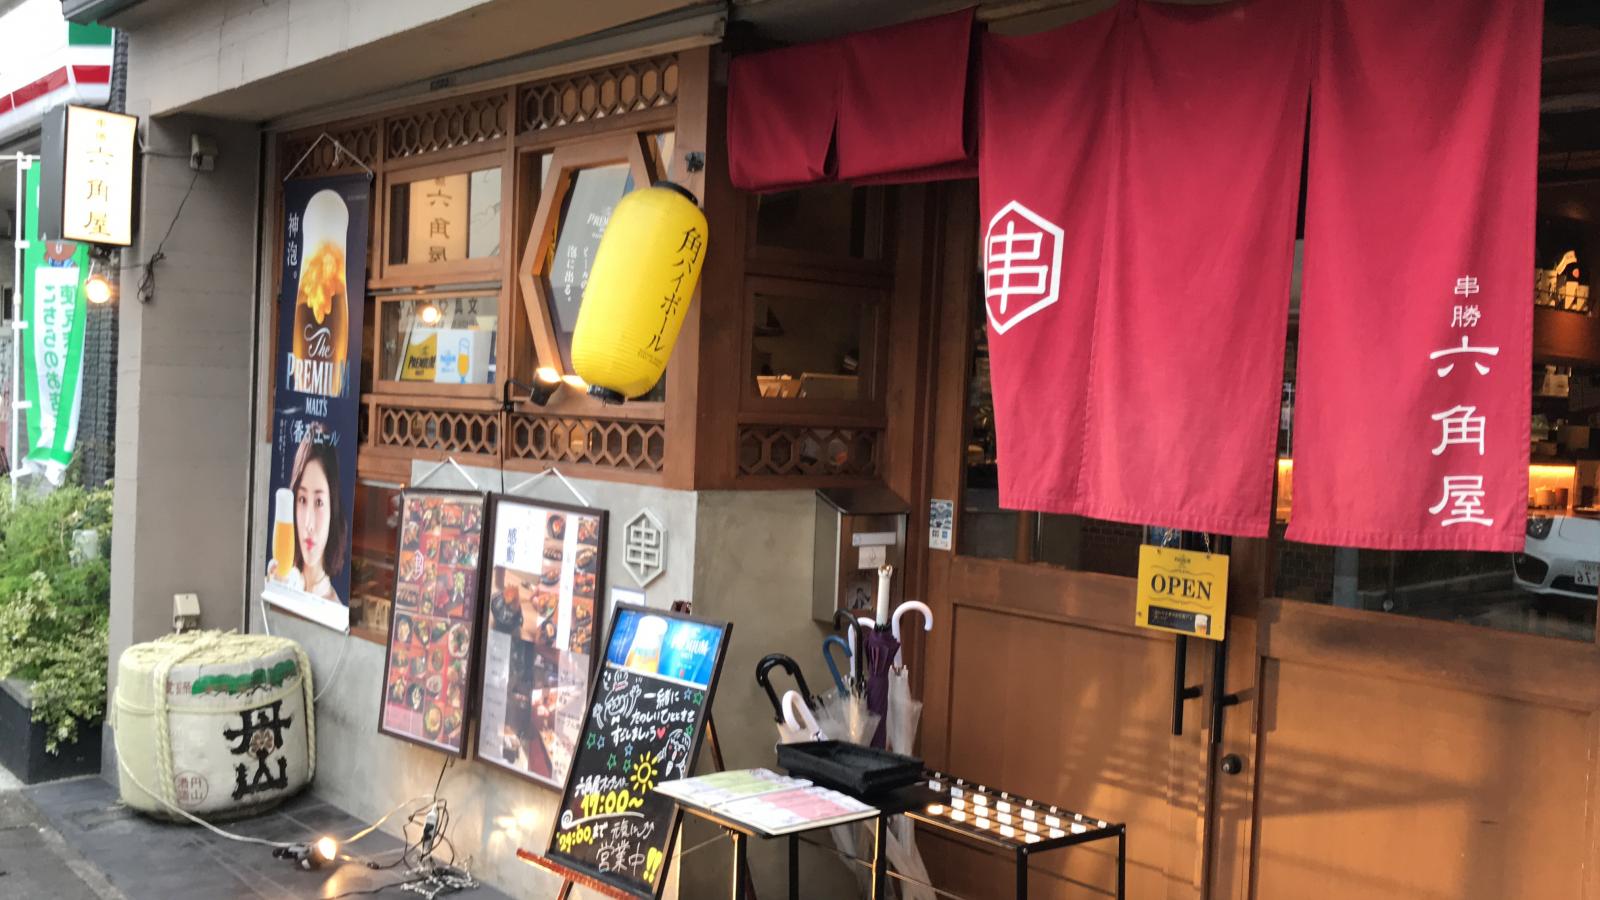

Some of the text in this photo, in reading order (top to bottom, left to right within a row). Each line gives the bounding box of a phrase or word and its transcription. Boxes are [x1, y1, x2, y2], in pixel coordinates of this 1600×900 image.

[647, 227, 703, 352] 角ハイボール
[987, 220, 1048, 314] 串
[1451, 275, 1481, 328] 串勝
[286, 352, 350, 398] PREMIUM
[1429, 335, 1500, 527] 六角屋
[626, 518, 659, 575] 串
[1151, 574, 1212, 601] OPEN
